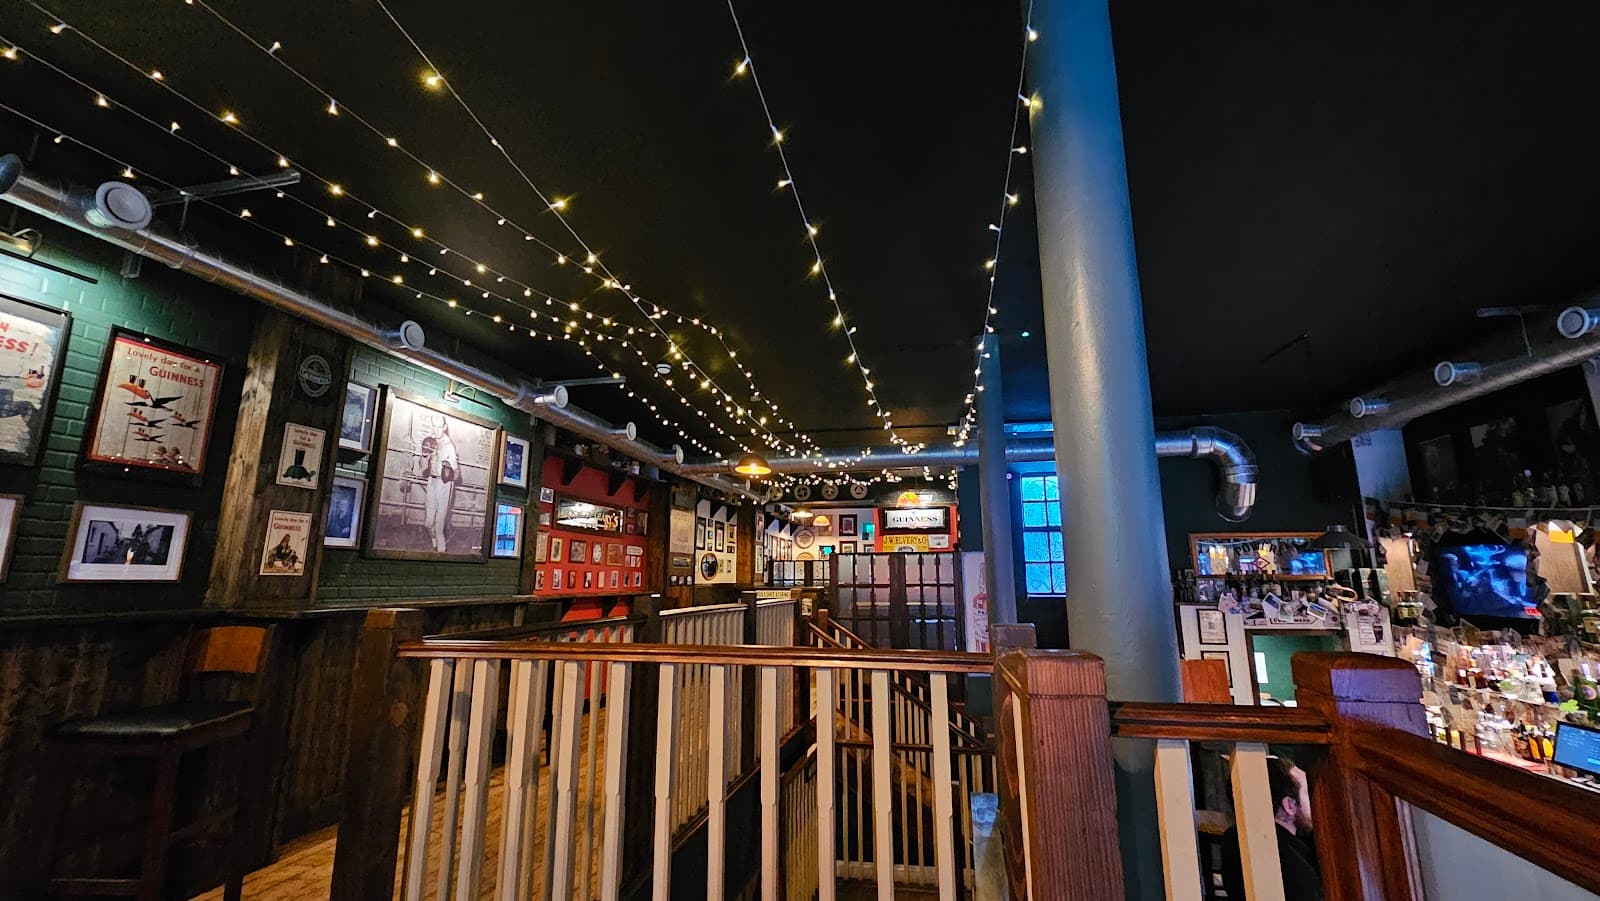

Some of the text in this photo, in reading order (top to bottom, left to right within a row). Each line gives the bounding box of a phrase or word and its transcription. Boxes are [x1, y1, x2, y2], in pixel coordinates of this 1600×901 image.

[127, 347, 158, 363] Lovely
[180, 361, 191, 371] for
[149, 366, 204, 388] GUINNESS
